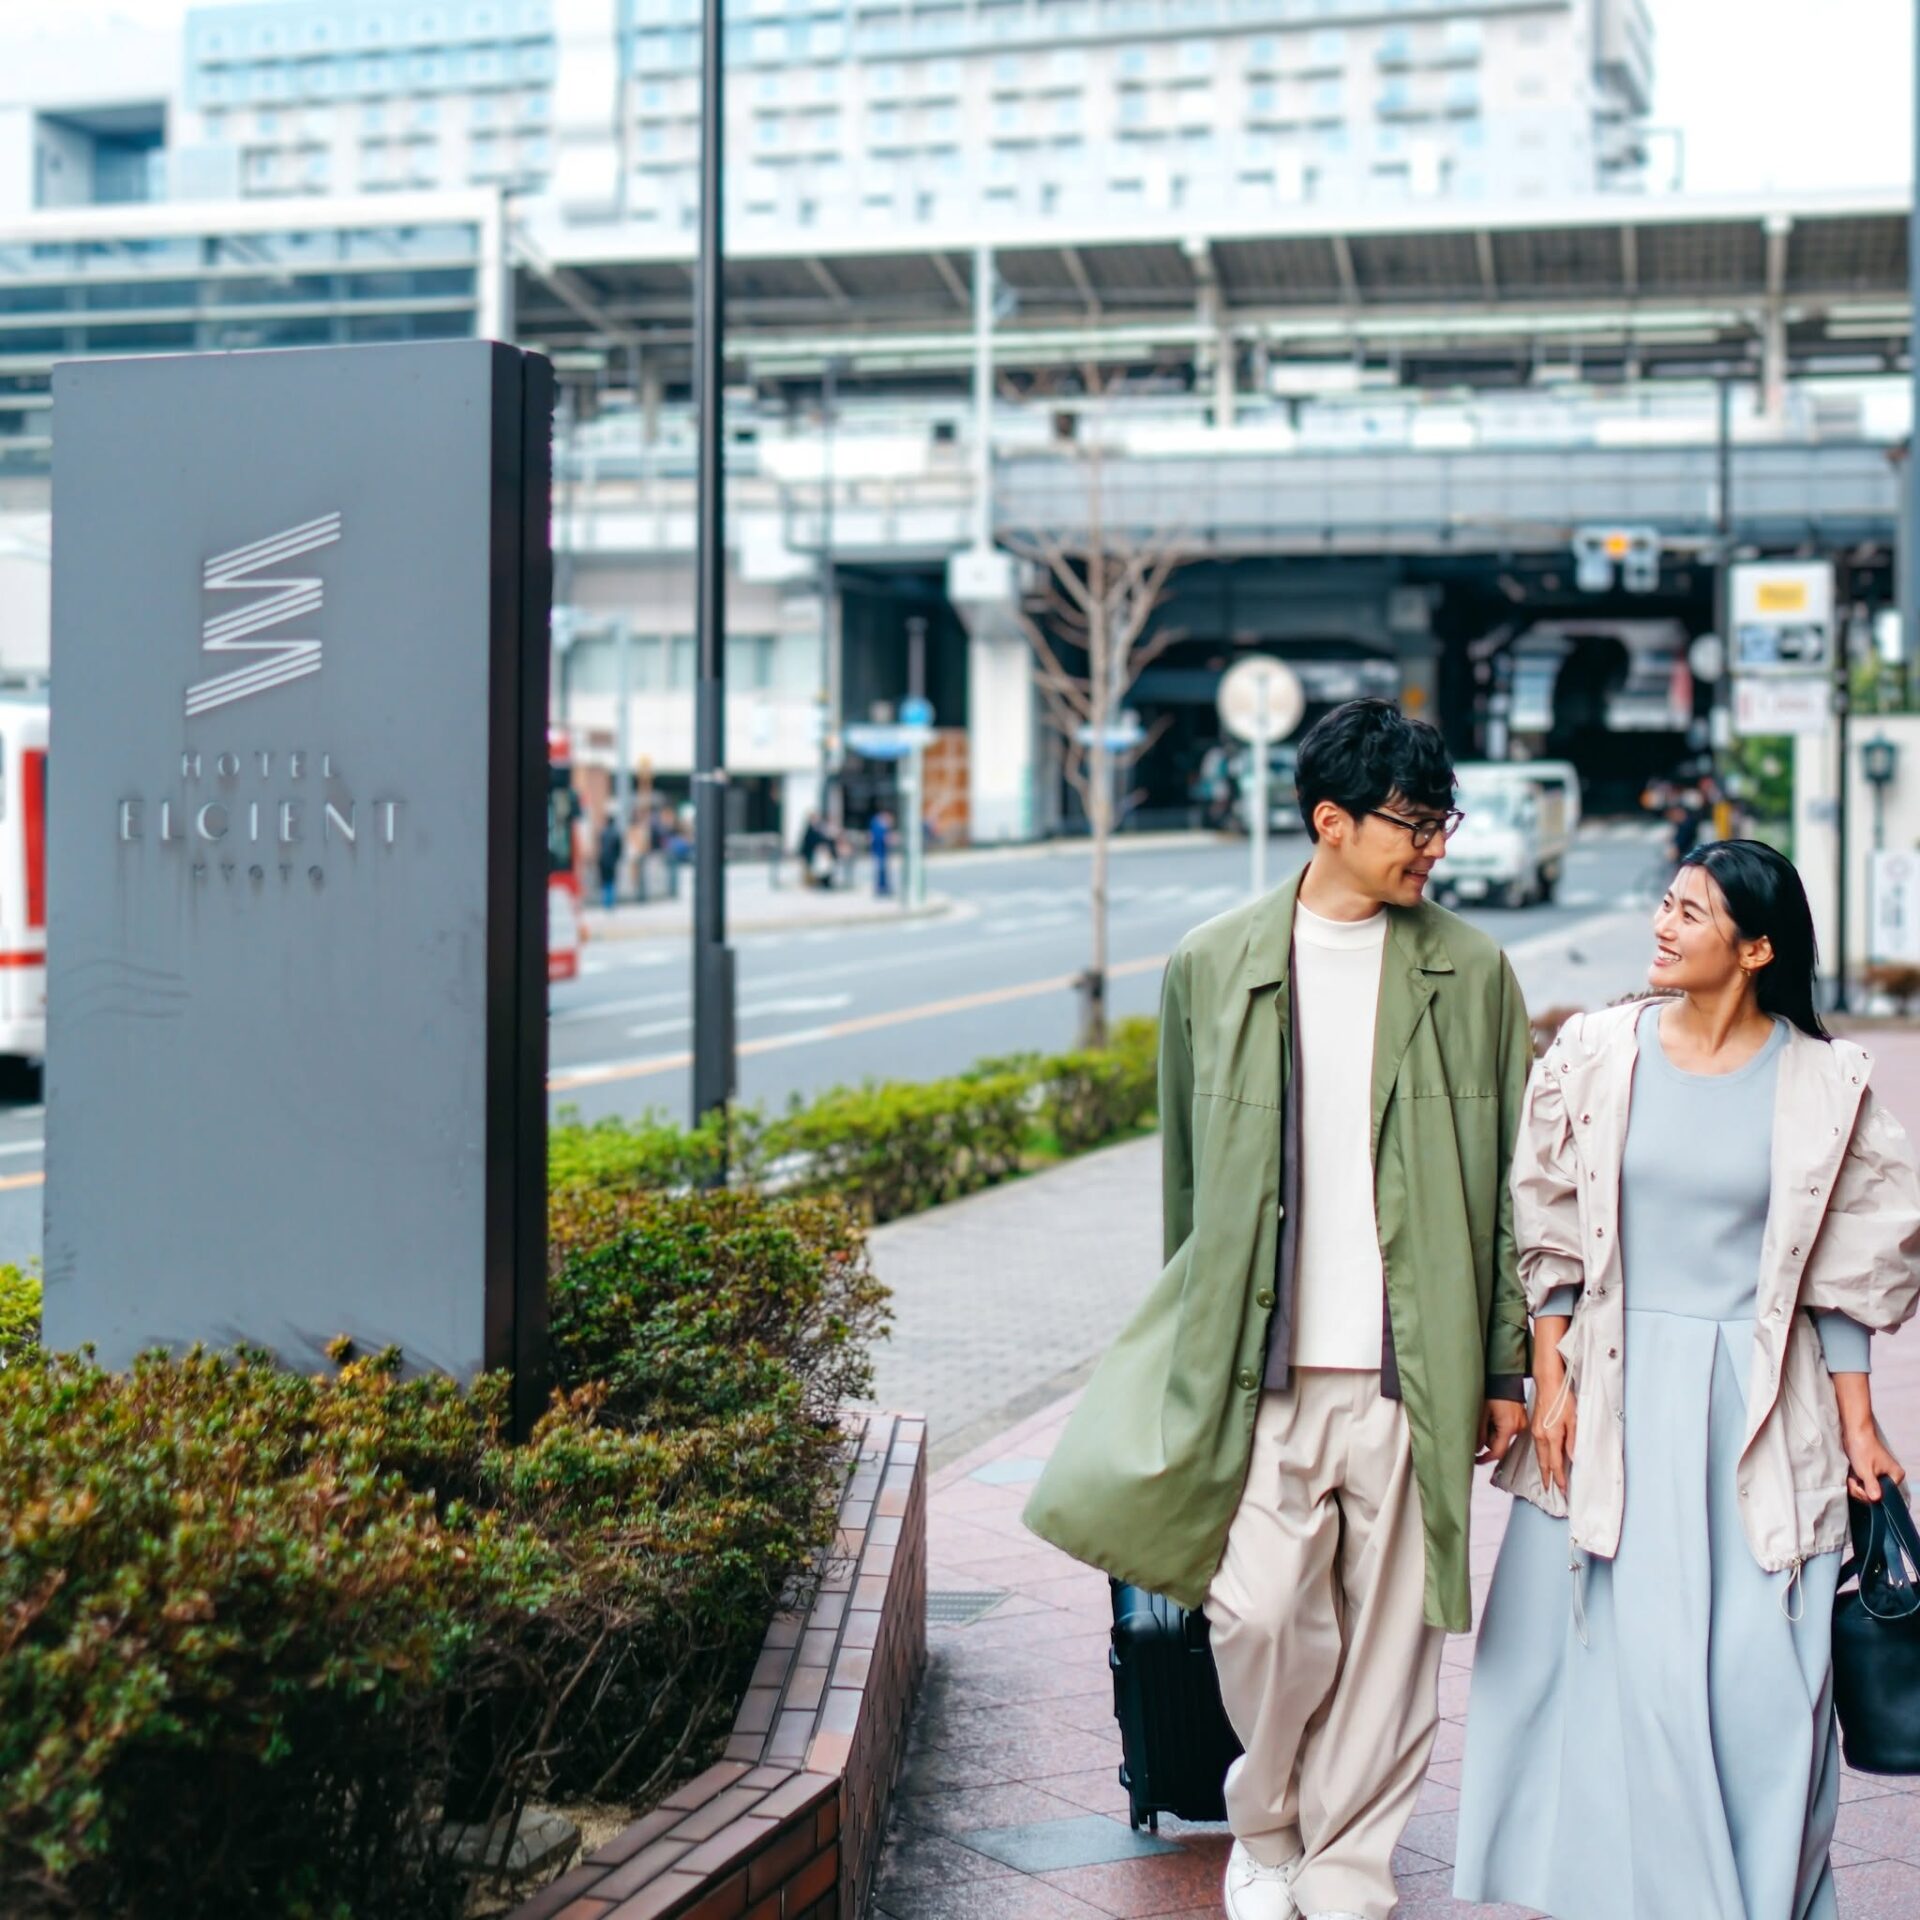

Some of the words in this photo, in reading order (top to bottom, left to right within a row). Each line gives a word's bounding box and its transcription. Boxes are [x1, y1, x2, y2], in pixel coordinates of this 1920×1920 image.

[181, 752, 341, 779] HOTEL
[119, 798, 406, 842] ELCIENT
[193, 863, 325, 883] KYOTO
